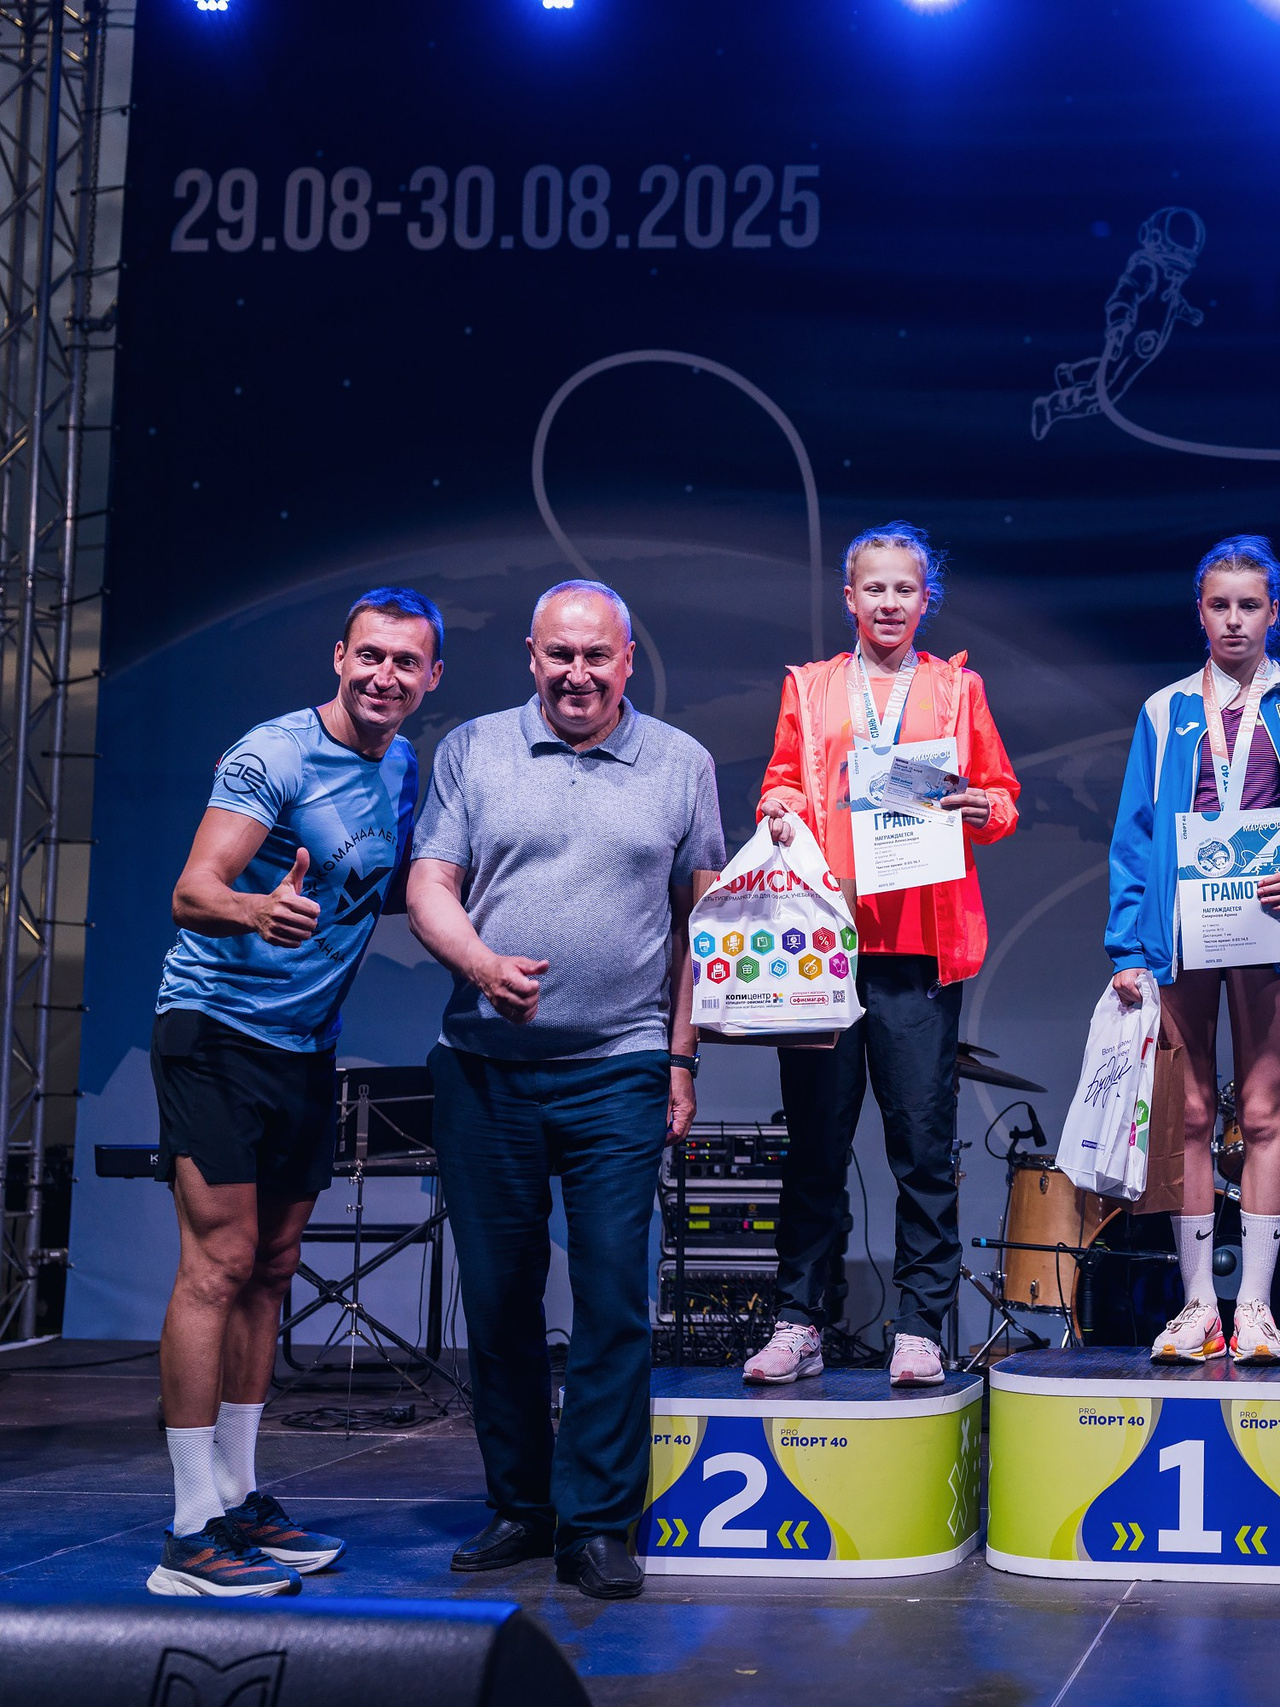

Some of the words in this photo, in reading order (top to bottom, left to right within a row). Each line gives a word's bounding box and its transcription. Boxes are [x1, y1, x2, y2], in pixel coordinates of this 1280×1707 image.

[170, 163, 822, 252] 29.08-30.08.2025
[874, 811, 928, 830] ГРАМ
[875, 831, 914, 841] НАГРАЖДАЕТСЯ
[1079, 1415, 1125, 1426] СПОРТ
[1127, 1416, 1145, 1426] 40
[674, 1435, 691, 1445] 40
[781, 1437, 828, 1447] СПОРТ
[830, 1437, 848, 1448] 40
[698, 1451, 768, 1549] 2
[1158, 1439, 1222, 1554] 1
